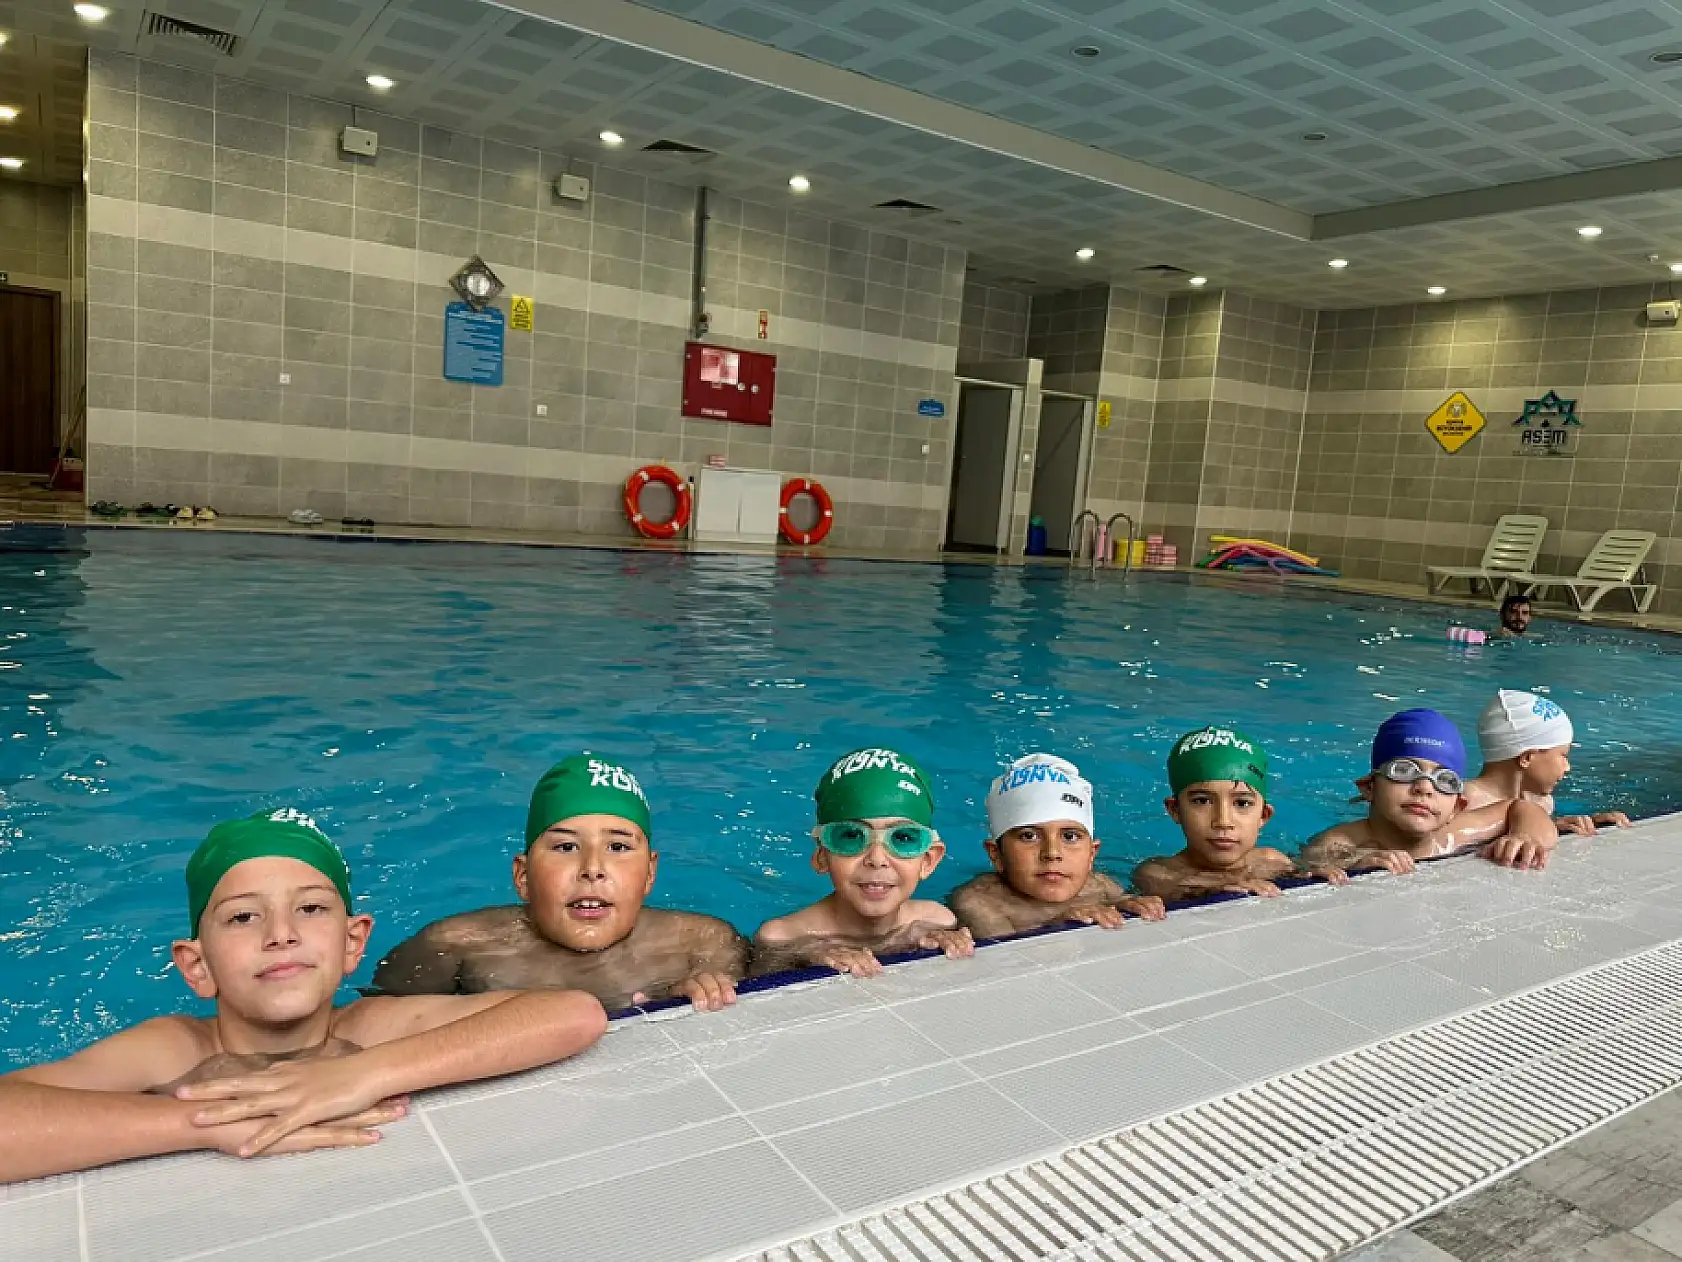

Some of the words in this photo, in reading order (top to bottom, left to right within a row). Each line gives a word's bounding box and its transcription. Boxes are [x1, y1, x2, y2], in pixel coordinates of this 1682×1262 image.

[1521, 429, 1567, 444] ASEM
[1179, 735, 1254, 755] KONYA
[831, 755, 916, 784] KONYA
[999, 766, 1070, 795] KONYA
[590, 773, 650, 811] KON
